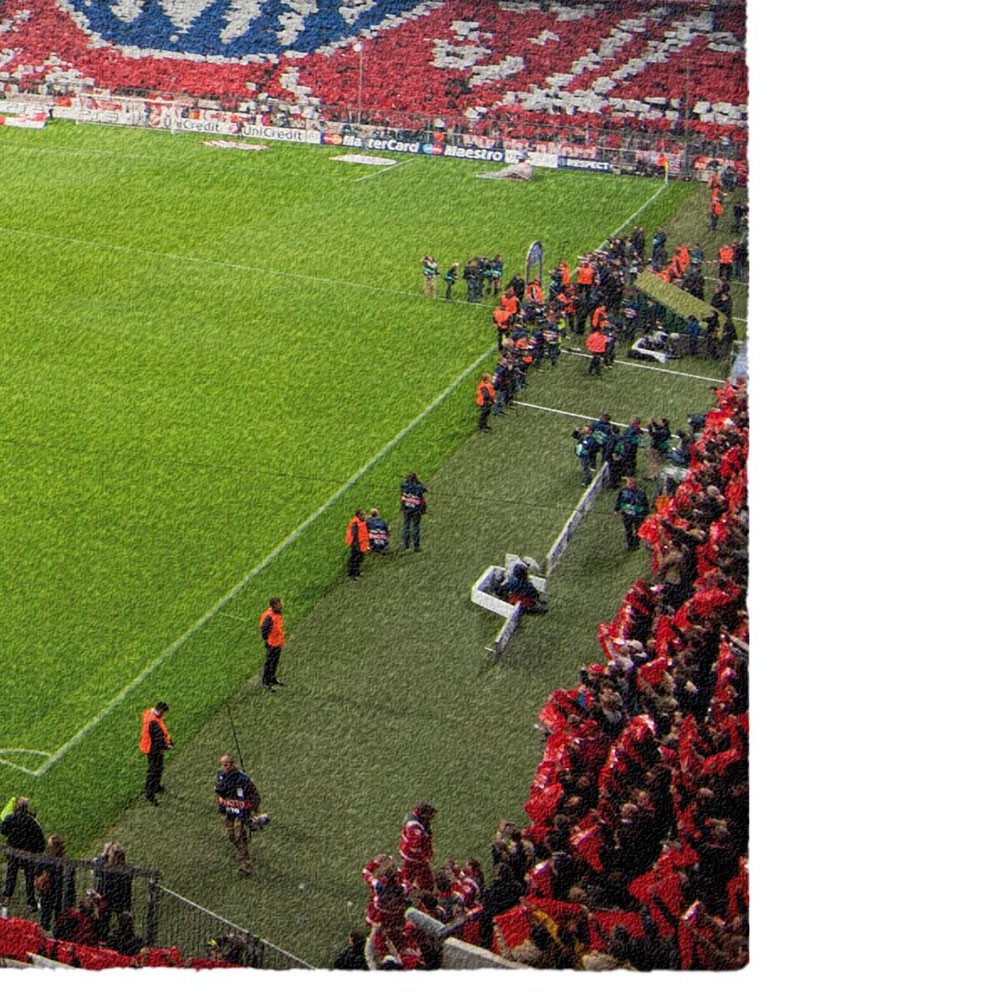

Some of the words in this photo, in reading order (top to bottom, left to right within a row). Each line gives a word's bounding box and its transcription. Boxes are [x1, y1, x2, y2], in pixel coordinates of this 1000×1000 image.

[163, 115, 220, 133] UniCredit
[244, 126, 302, 141] UniCredit
[343, 135, 420, 153] MaterCard
[444, 145, 503, 161] Maestro
[567, 158, 609, 171] RESPECT
